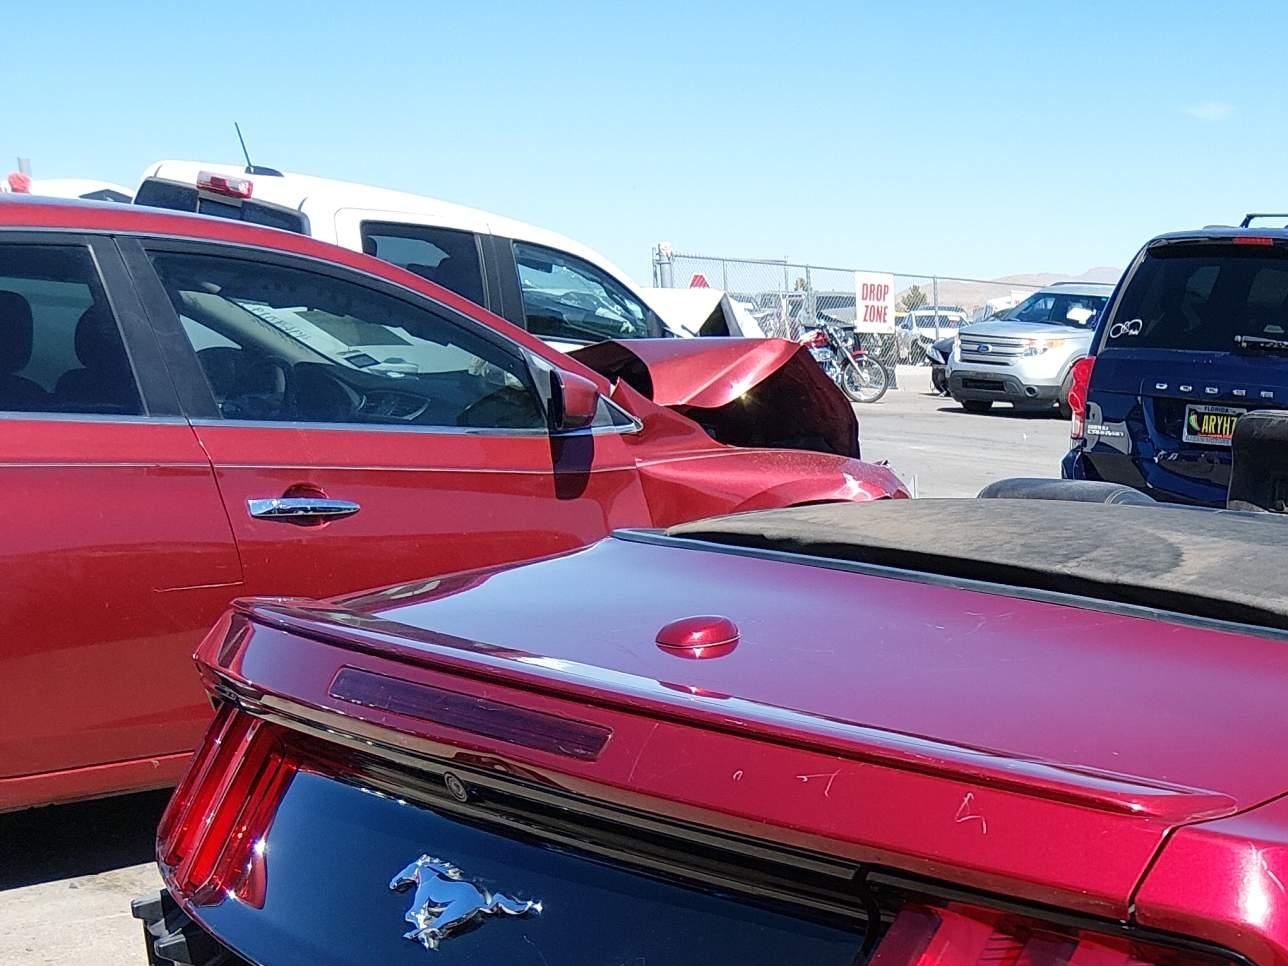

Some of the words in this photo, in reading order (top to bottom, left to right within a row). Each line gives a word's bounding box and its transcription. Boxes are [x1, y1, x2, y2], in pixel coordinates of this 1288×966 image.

[861, 283, 889, 302] DROP
[863, 304, 888, 323] ZONE
[1155, 382, 1274, 399] DODGE
